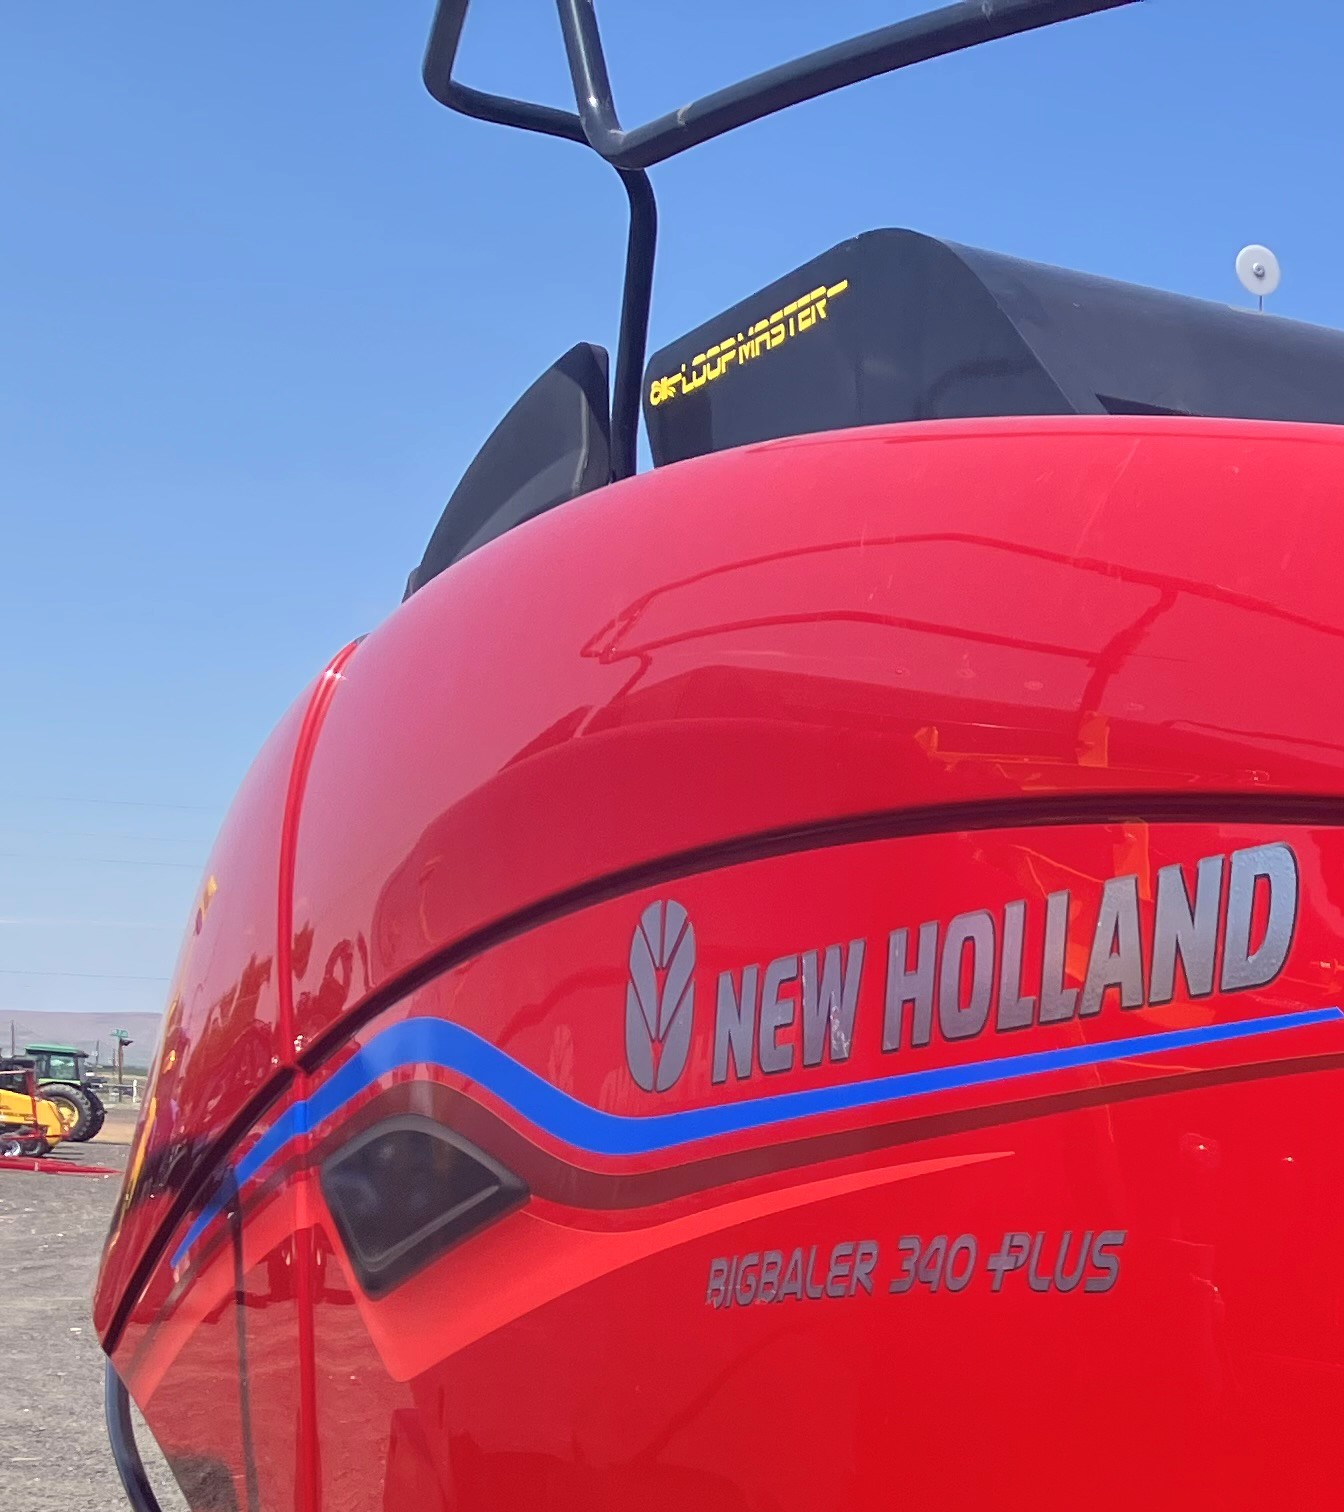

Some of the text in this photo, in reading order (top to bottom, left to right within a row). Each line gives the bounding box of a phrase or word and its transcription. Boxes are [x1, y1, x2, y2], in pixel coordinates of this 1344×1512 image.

[711, 841, 1300, 1086] NEW HOLLAND
[705, 1230, 1128, 1309] BIGBALER 340 PLUS
